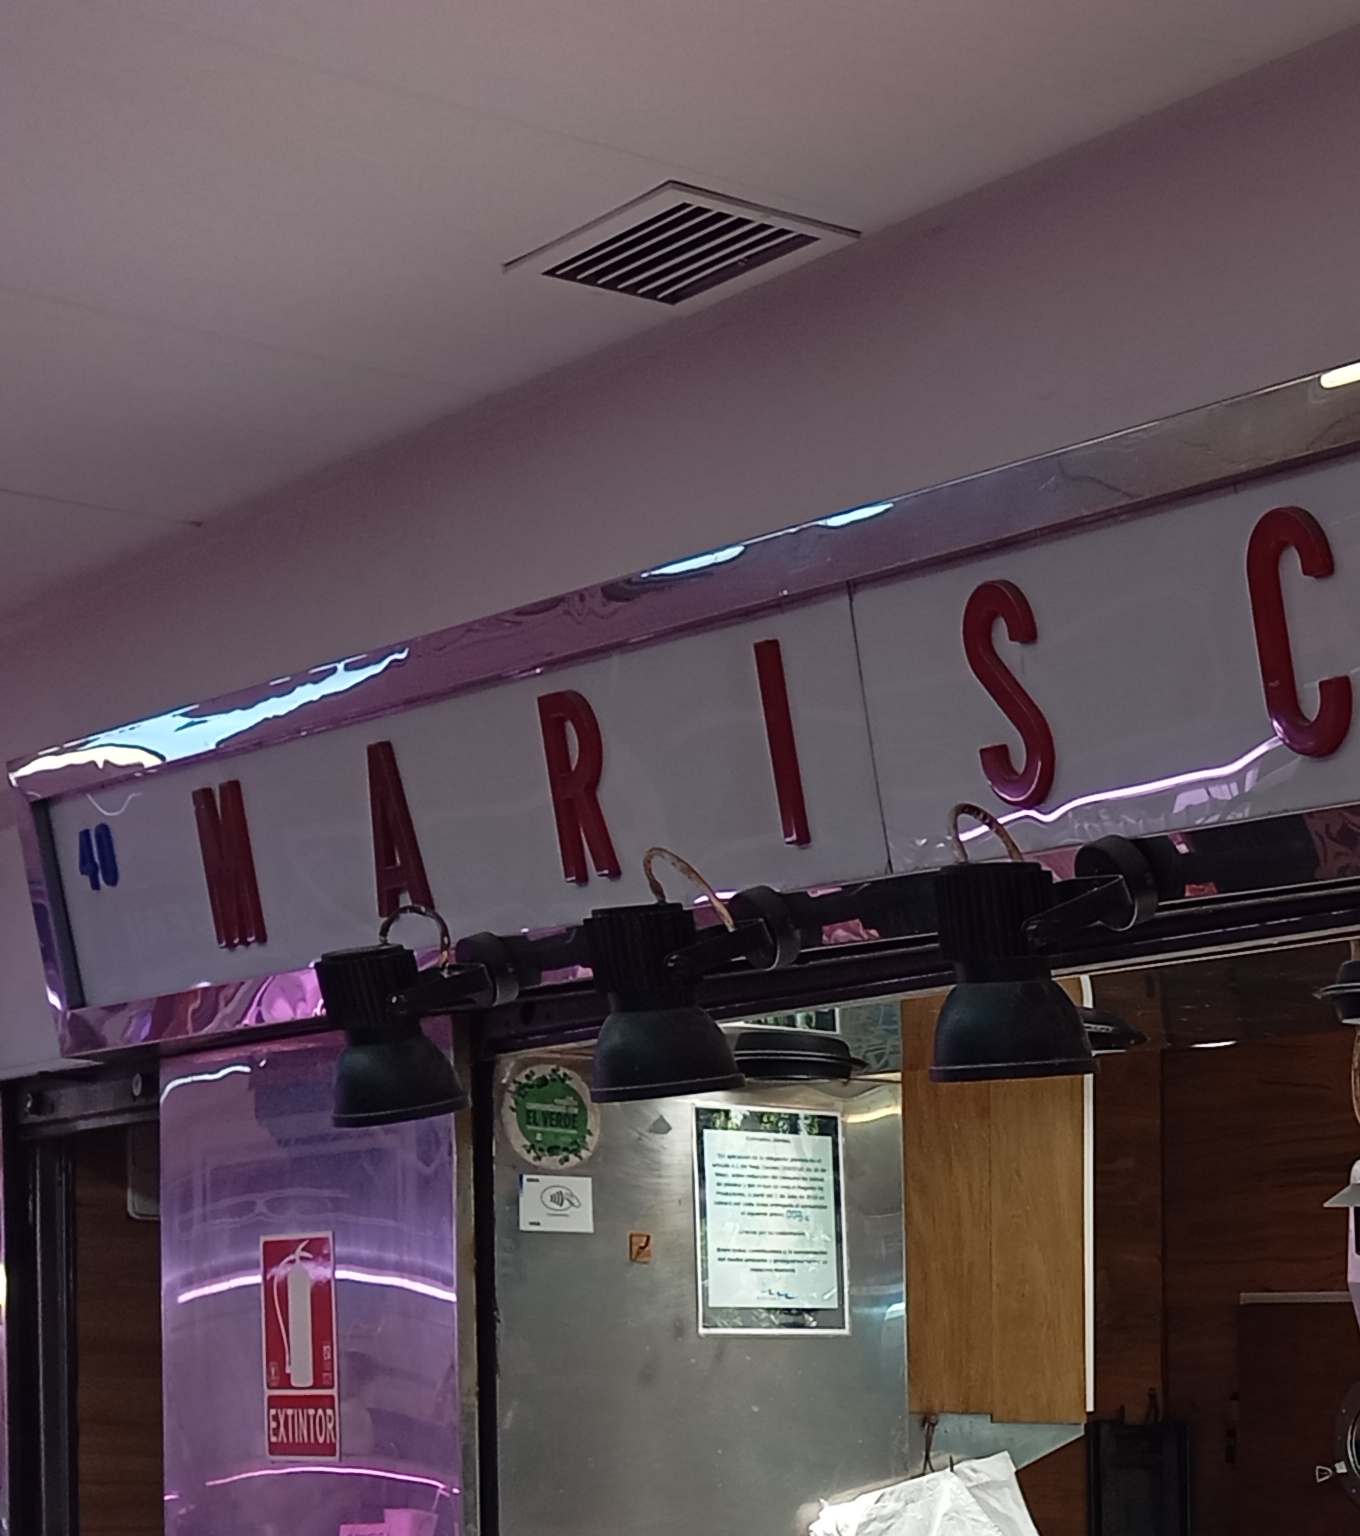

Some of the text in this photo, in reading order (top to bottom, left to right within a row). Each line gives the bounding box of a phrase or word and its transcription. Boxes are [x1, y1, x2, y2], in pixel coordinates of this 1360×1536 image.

[78, 823, 119, 891] 40
[542, 1111, 579, 1129] VERDE
[269, 1407, 336, 1444] EXTINTOR
